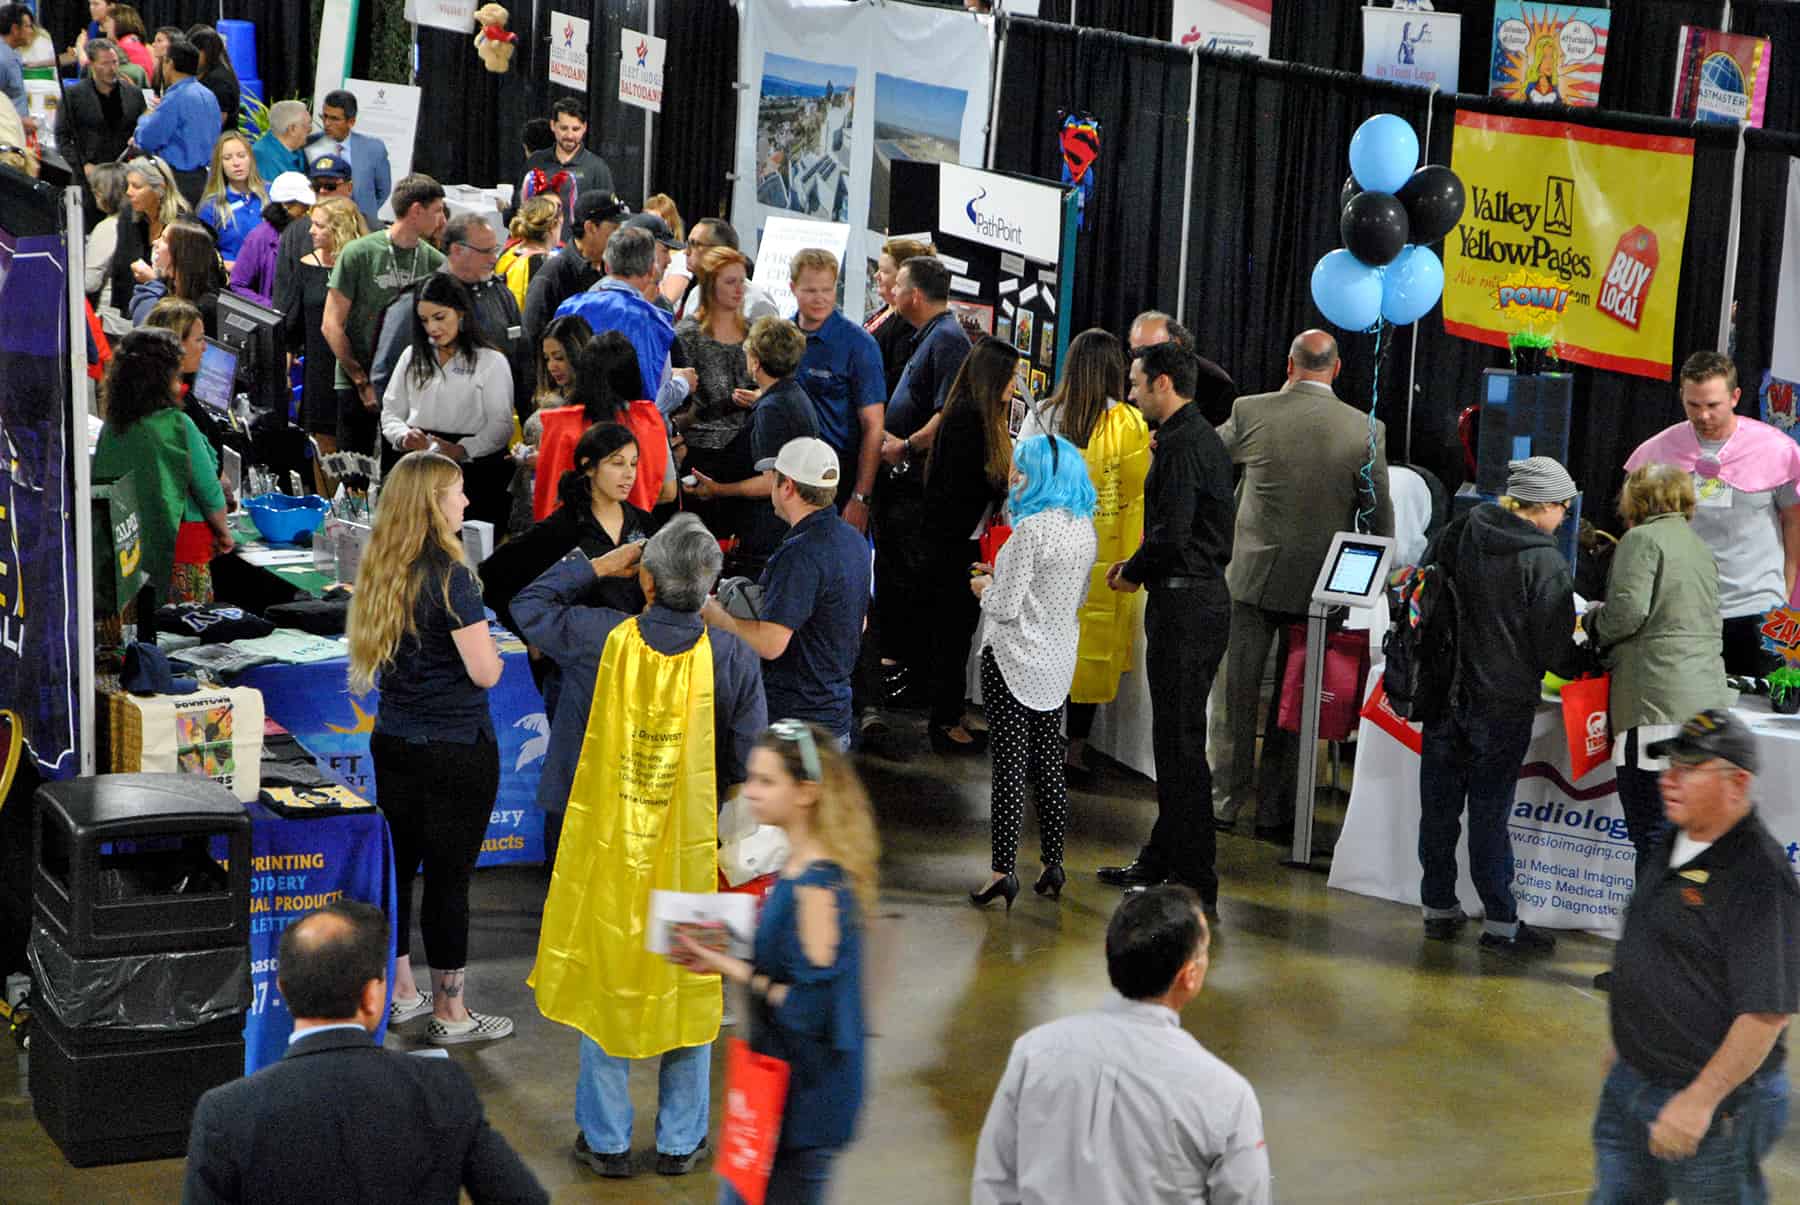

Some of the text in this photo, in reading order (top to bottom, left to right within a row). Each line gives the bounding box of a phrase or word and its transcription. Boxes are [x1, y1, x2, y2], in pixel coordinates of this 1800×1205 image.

[621, 79, 662, 103] BALTODANO
[1471, 185, 1541, 232] Valley
[976, 212, 1022, 245] PathPoint
[1459, 223, 1591, 280] YellowPages
[1608, 251, 1650, 298] BUY
[1499, 286, 1568, 313] POW!
[1600, 282, 1637, 324] LOCAL
[489, 809, 525, 828] ery
[1514, 801, 1630, 840] adiolog
[480, 834, 525, 852] ucts
[1516, 873, 1552, 890] Cities
[1530, 860, 1580, 879] Medical
[1584, 869, 1633, 890] Imaging
